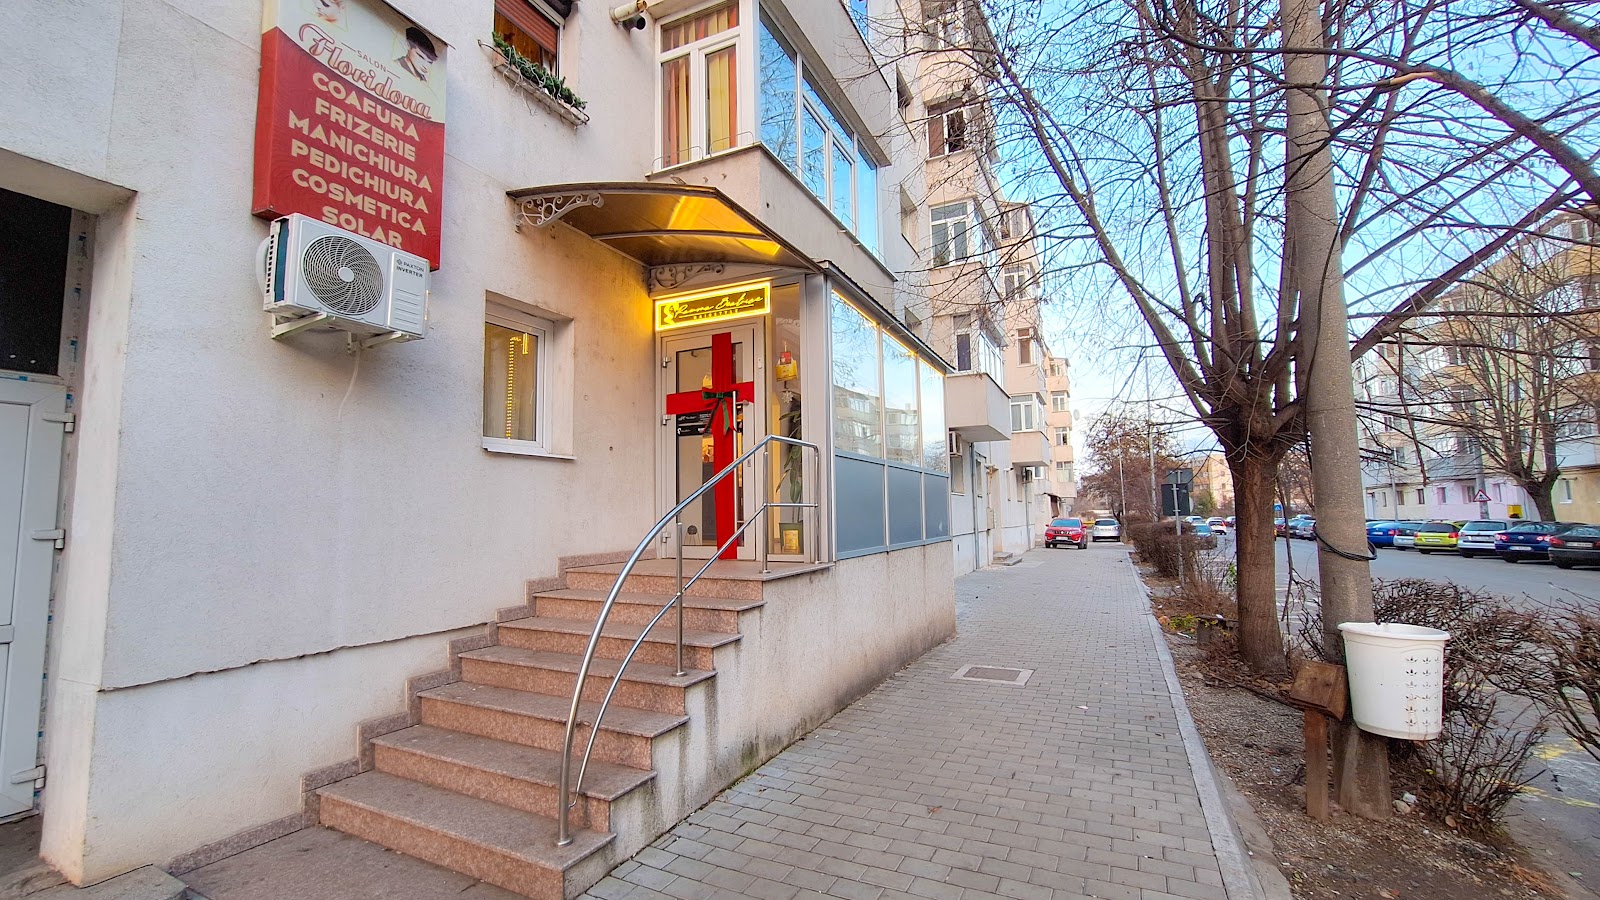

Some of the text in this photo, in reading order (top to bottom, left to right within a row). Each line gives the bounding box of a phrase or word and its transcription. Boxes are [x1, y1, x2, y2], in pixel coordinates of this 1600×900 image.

[356, 50, 387, 73] SALON
[313, 72, 420, 141] COAFURA
[315, 97, 416, 162] FRIZERIE
[288, 110, 433, 193] MANICHIURA
[291, 139, 429, 214] PEDICHIURA
[292, 168, 427, 236] COSMETICA
[322, 205, 403, 249] SOLAR
[396, 265, 424, 278] INVERTER
